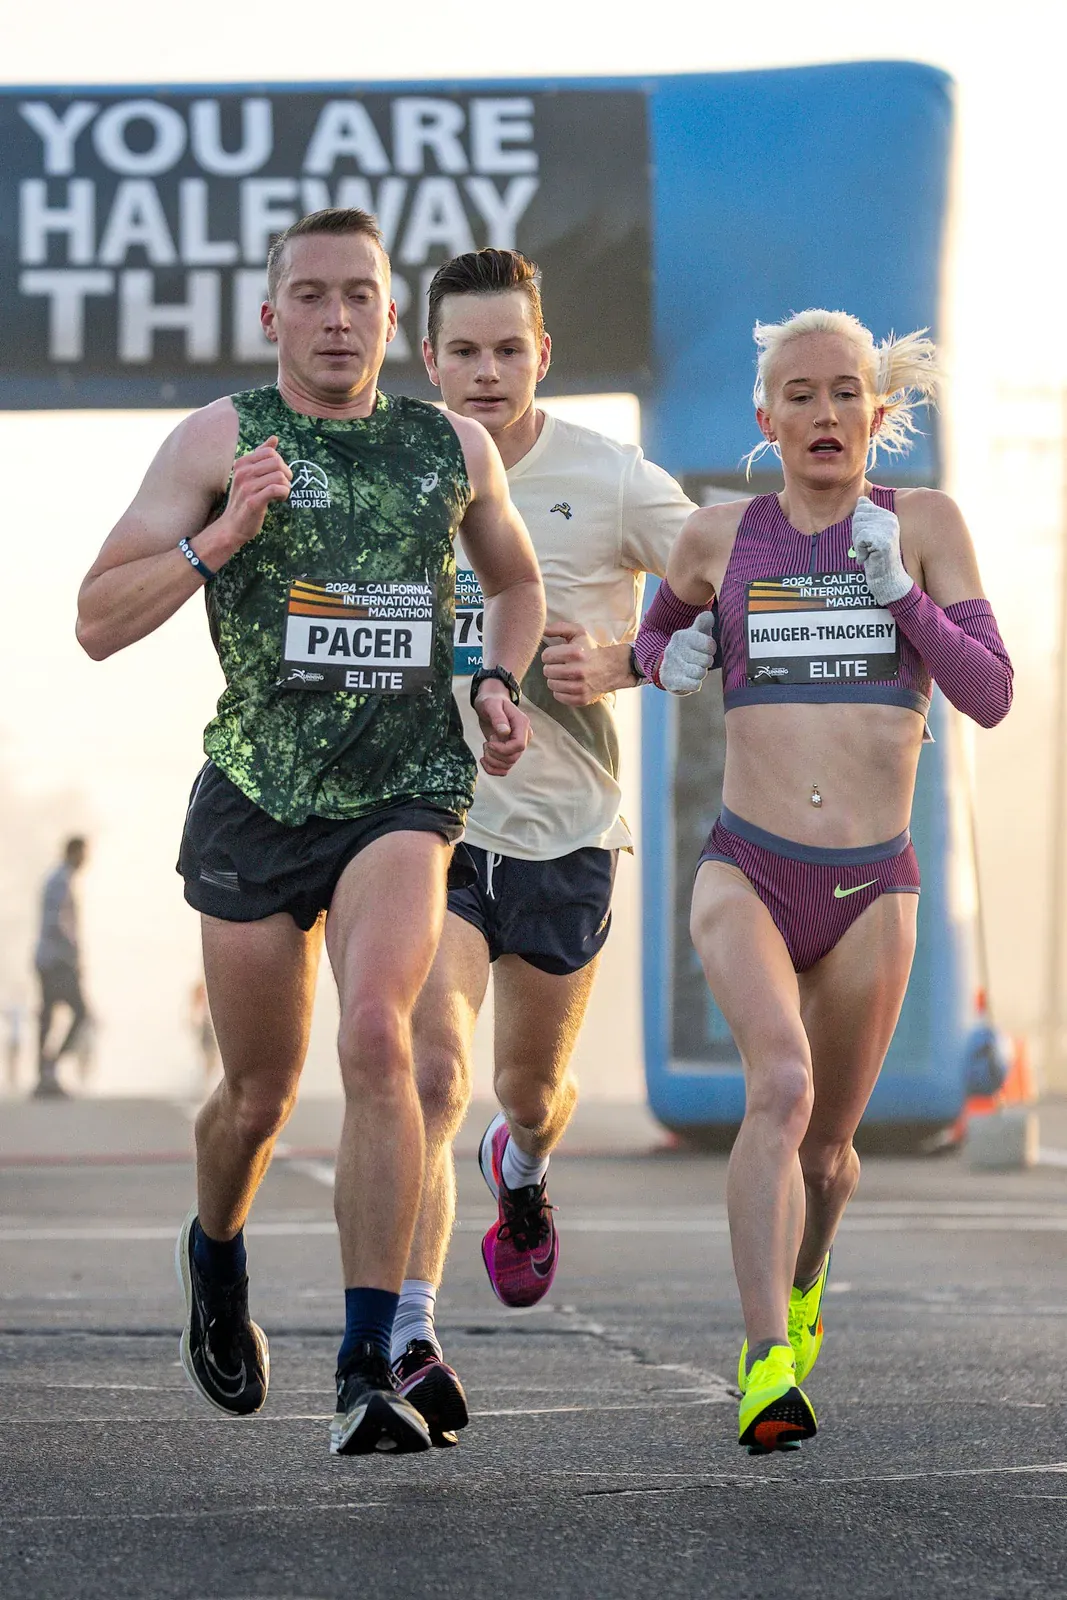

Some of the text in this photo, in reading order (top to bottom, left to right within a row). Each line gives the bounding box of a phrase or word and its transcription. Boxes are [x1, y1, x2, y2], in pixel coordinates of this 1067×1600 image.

[17, 96, 540, 177] YOU ARE
[290, 489, 331, 499] ALTITUDE
[291, 499, 331, 508] PROJECT
[781, 576, 813, 588] 2024
[325, 583, 357, 594] 2024
[366, 584, 432, 595] CALIFORNIA
[343, 594, 432, 607] INTERNATIONAL
[368, 607, 433, 618] MARATHON
[750, 623, 895, 644] HAUGER-THACKERY
[307, 625, 413, 659] PACER
[809, 660, 868, 679] ELITE
[345, 670, 403, 690] ELITE
